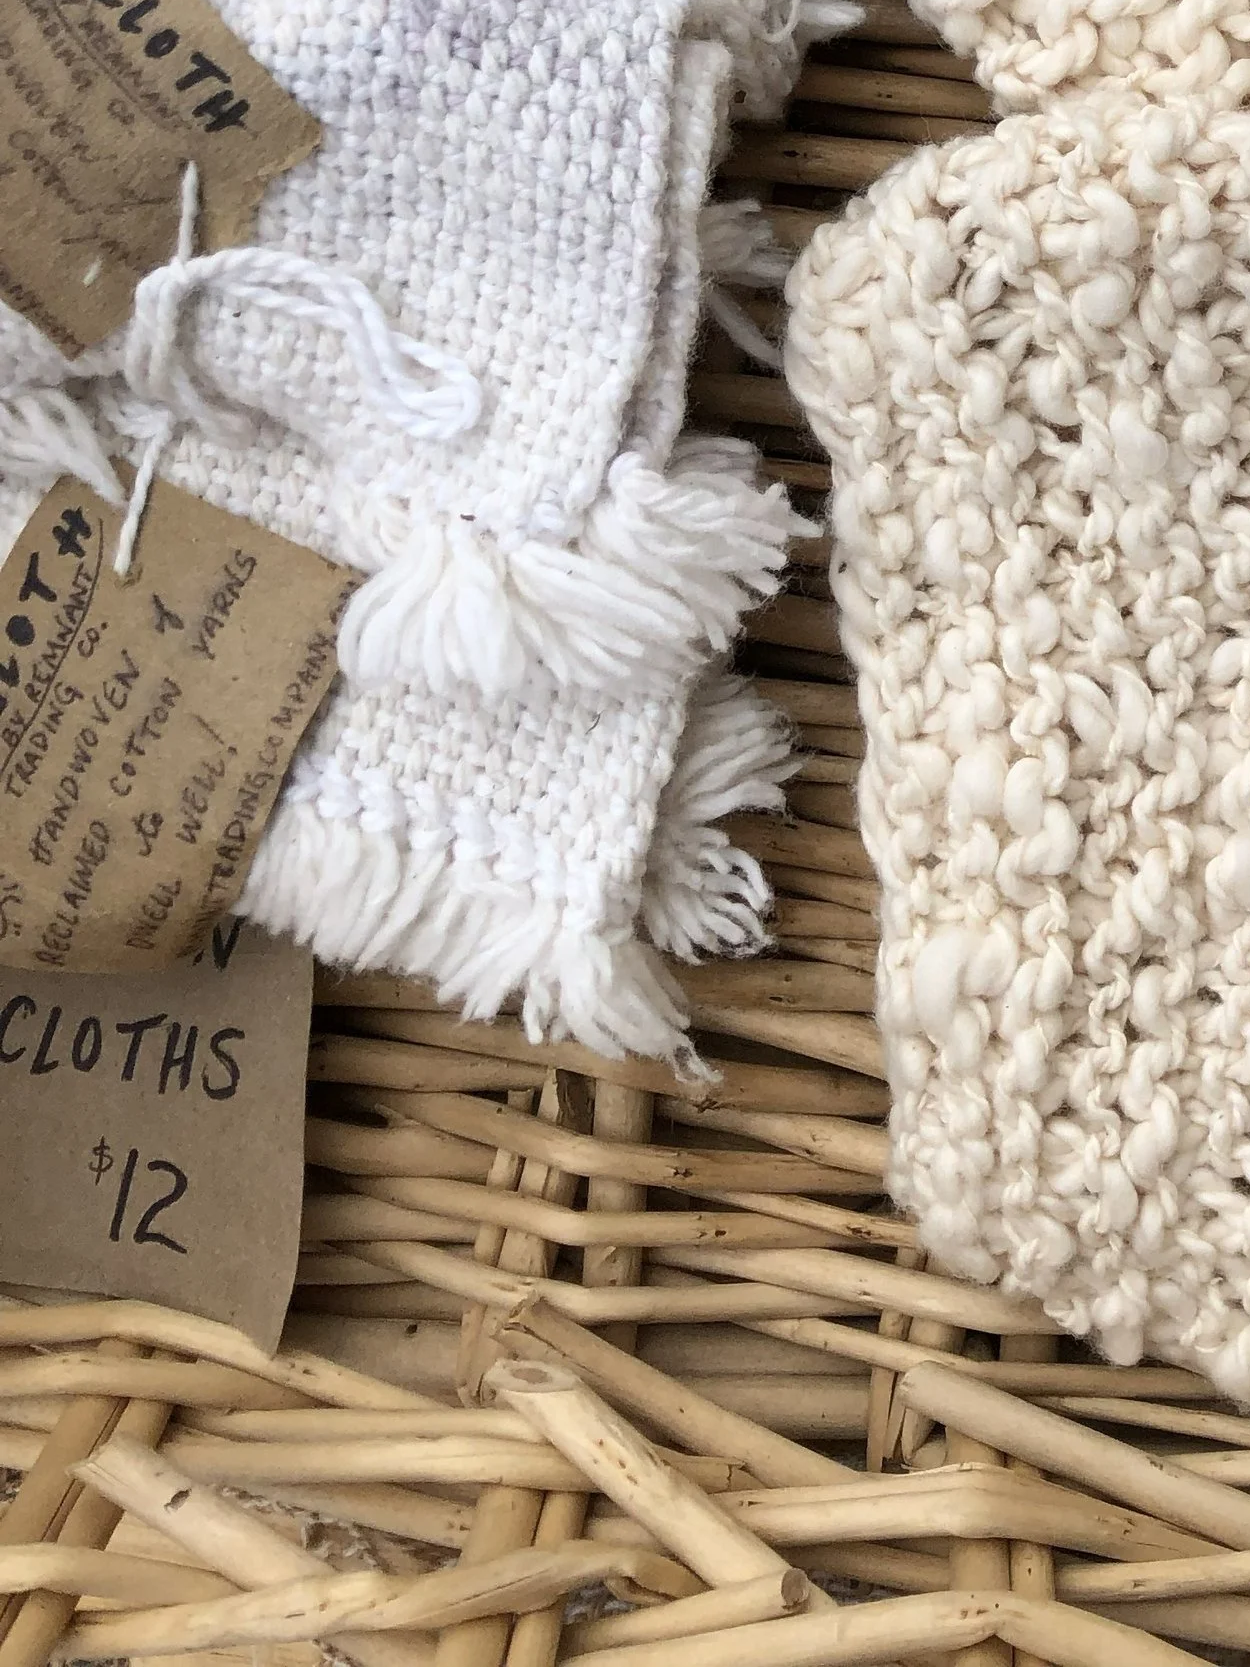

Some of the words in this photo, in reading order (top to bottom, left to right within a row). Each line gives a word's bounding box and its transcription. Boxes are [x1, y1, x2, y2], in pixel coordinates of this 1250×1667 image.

[0, 506, 92, 715] LOTH
[0, 710, 27, 750] BY
[25, 562, 92, 704] REMNANT
[4, 681, 84, 799] TRADING
[28, 648, 141, 866] HANDWOVEN
[34, 820, 111, 966] RECLAIMED
[108, 676, 182, 797] COTTON
[189, 549, 257, 661] YARNS
[175, 714, 238, 844] WELL!
[88, 1135, 188, 1254] $12
